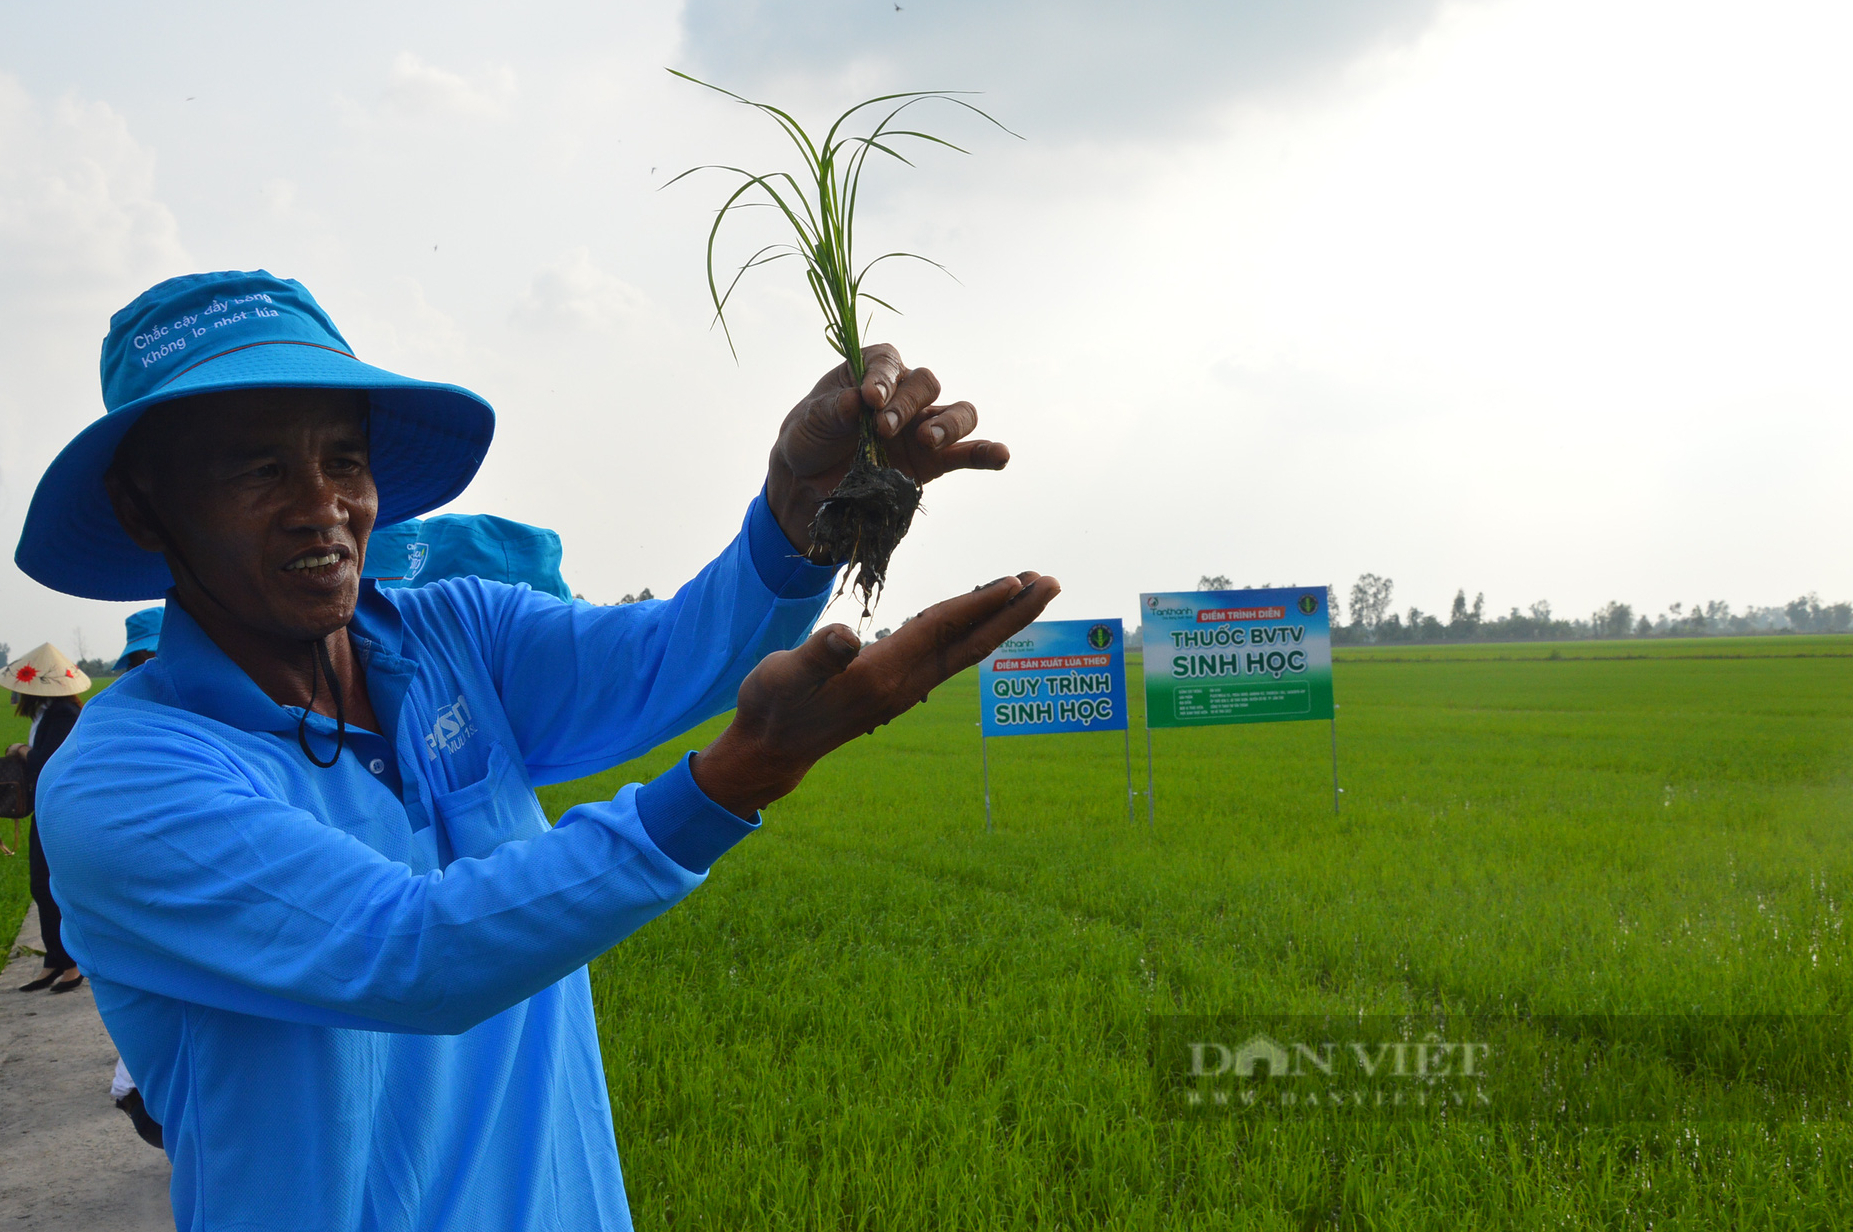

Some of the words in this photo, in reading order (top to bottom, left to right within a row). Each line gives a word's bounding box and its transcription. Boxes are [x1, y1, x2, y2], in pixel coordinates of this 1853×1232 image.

[133, 324, 169, 349] Chắc
[141, 336, 186, 368] Không
[192, 327, 207, 338] lo
[255, 307, 279, 318] lúa
[1201, 610, 1226, 621] ĐIỂM
[1227, 609, 1256, 619] TRÌNH
[1170, 623, 1245, 648] THUỐC
[1250, 624, 1305, 645] BVTV
[996, 659, 1019, 670] ĐIỂM
[1040, 658, 1063, 668] XUẤT
[1065, 657, 1082, 666] LÚA
[1083, 656, 1107, 666] THEO
[1172, 653, 1239, 678] SINH
[1246, 650, 1308, 680] HỌC
[993, 677, 1041, 698] QUY
[1045, 670, 1111, 696] TRÌNH
[995, 700, 1054, 725] SINH
[1058, 697, 1112, 726] HỌC
